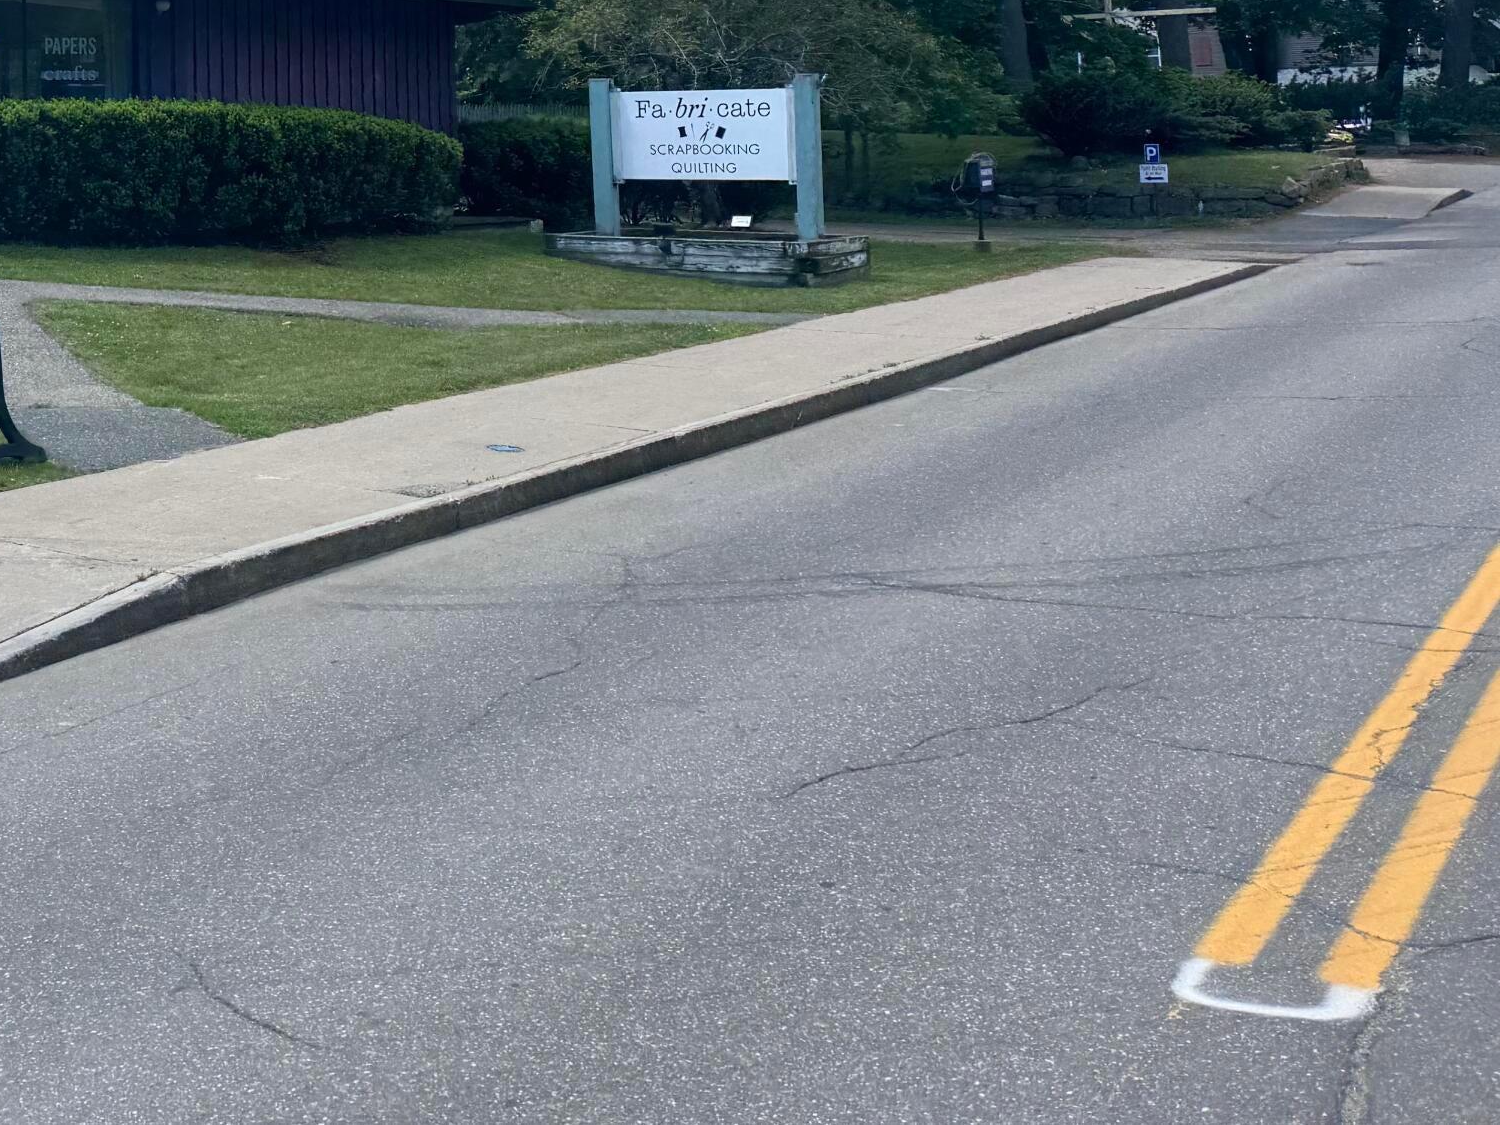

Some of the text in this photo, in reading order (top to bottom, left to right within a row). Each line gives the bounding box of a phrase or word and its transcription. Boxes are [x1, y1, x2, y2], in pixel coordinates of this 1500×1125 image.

[44, 36, 97, 55] PAPERS
[43, 65, 97, 81] crafts
[649, 143, 761, 156] SCRAPBOOKING
[1146, 146, 1157, 161] P
[671, 162, 737, 174] QUILTING
